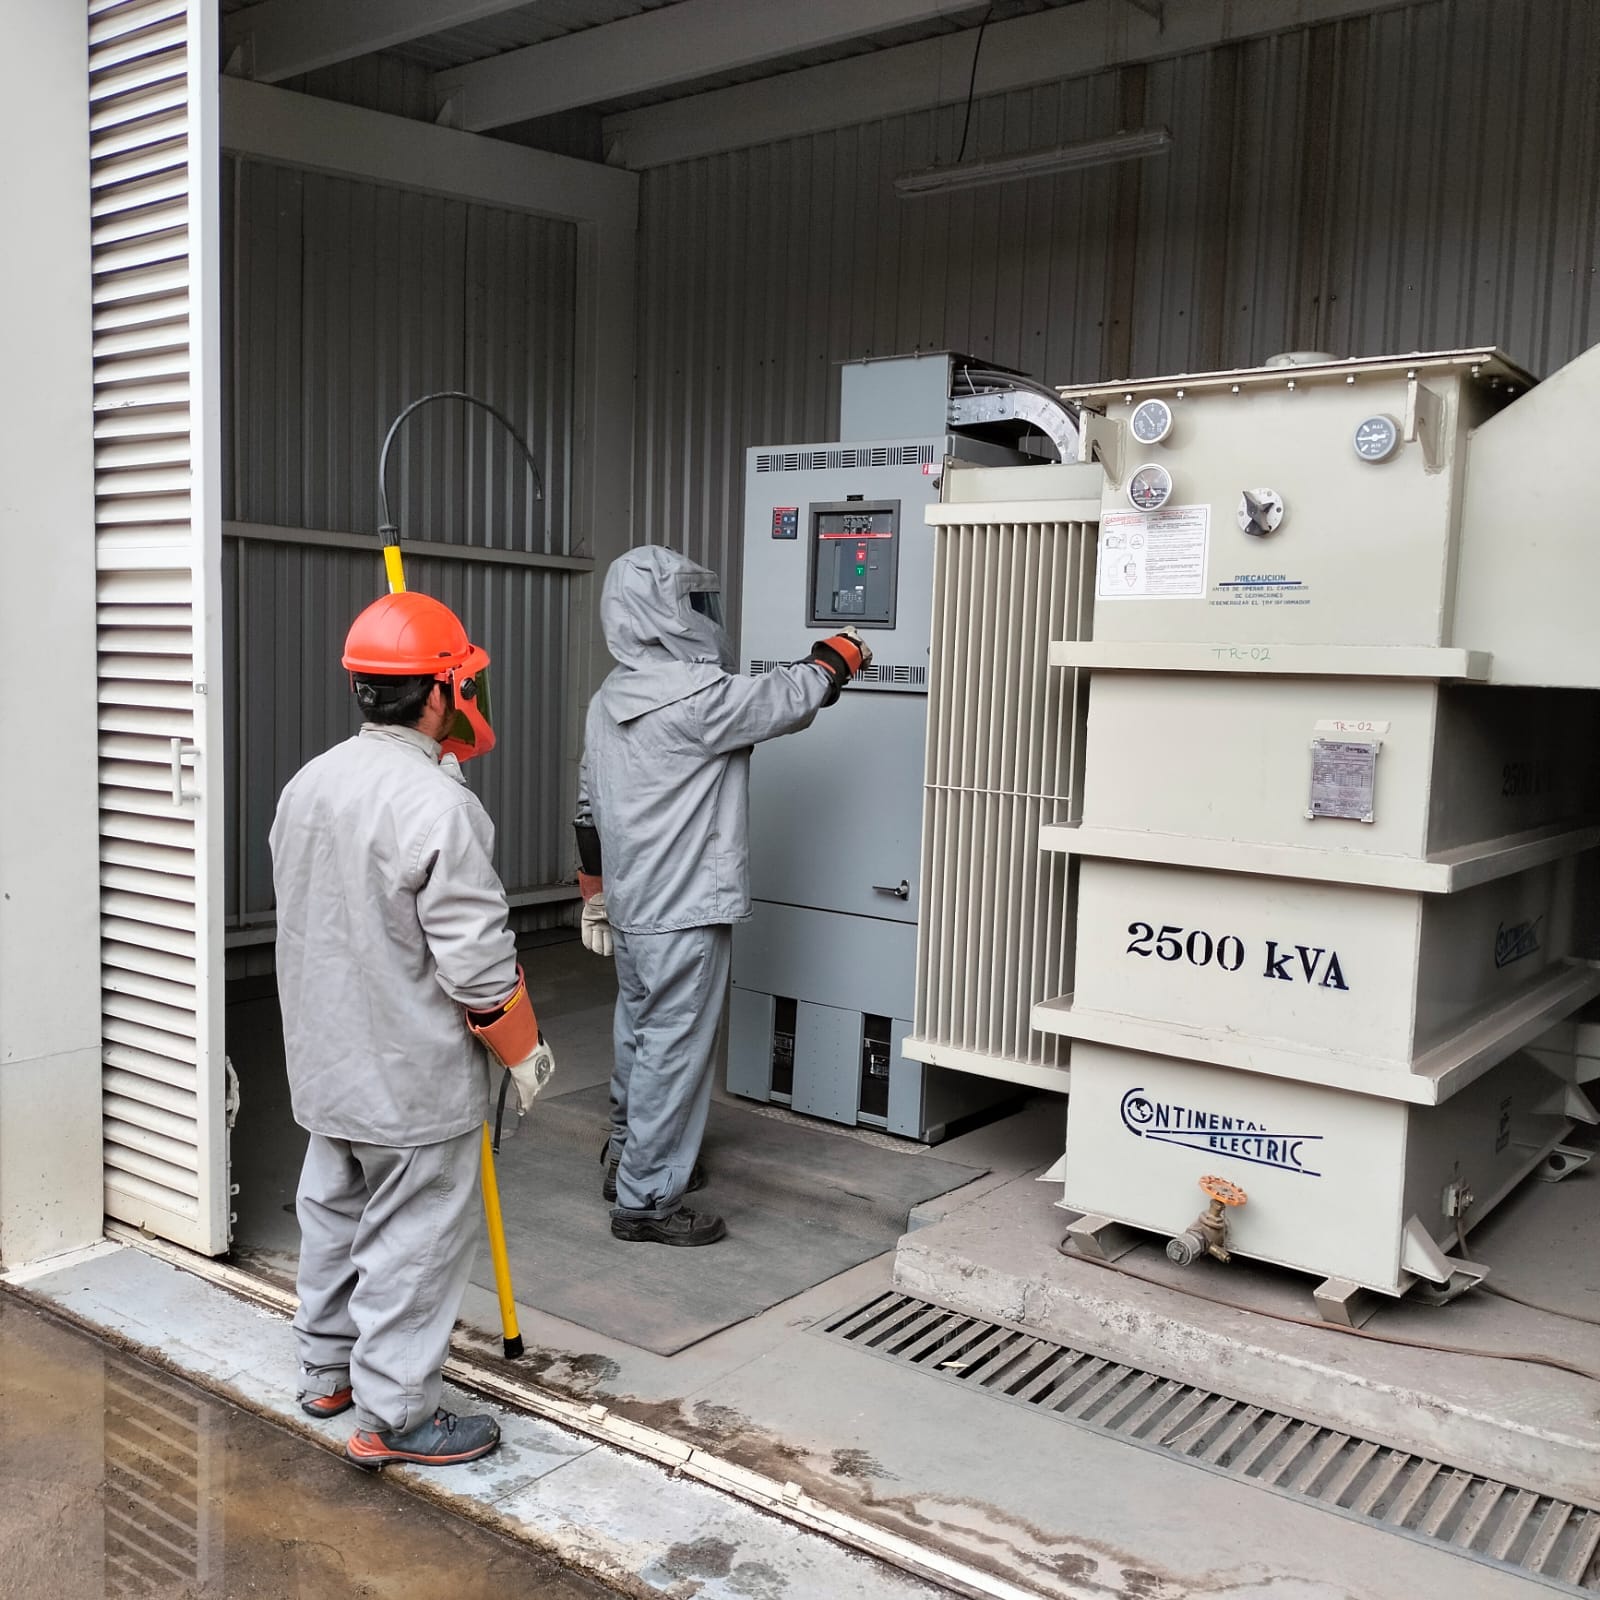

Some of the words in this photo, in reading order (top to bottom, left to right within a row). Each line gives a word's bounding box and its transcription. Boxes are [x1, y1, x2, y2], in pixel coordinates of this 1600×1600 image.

[1234, 574, 1286, 582] PRECAUCION
[1210, 647, 1272, 661] TR-02
[1126, 922, 1245, 971] 2500
[1263, 940, 1350, 990] kVA
[1209, 1135, 1304, 1167] ELECTRIC
